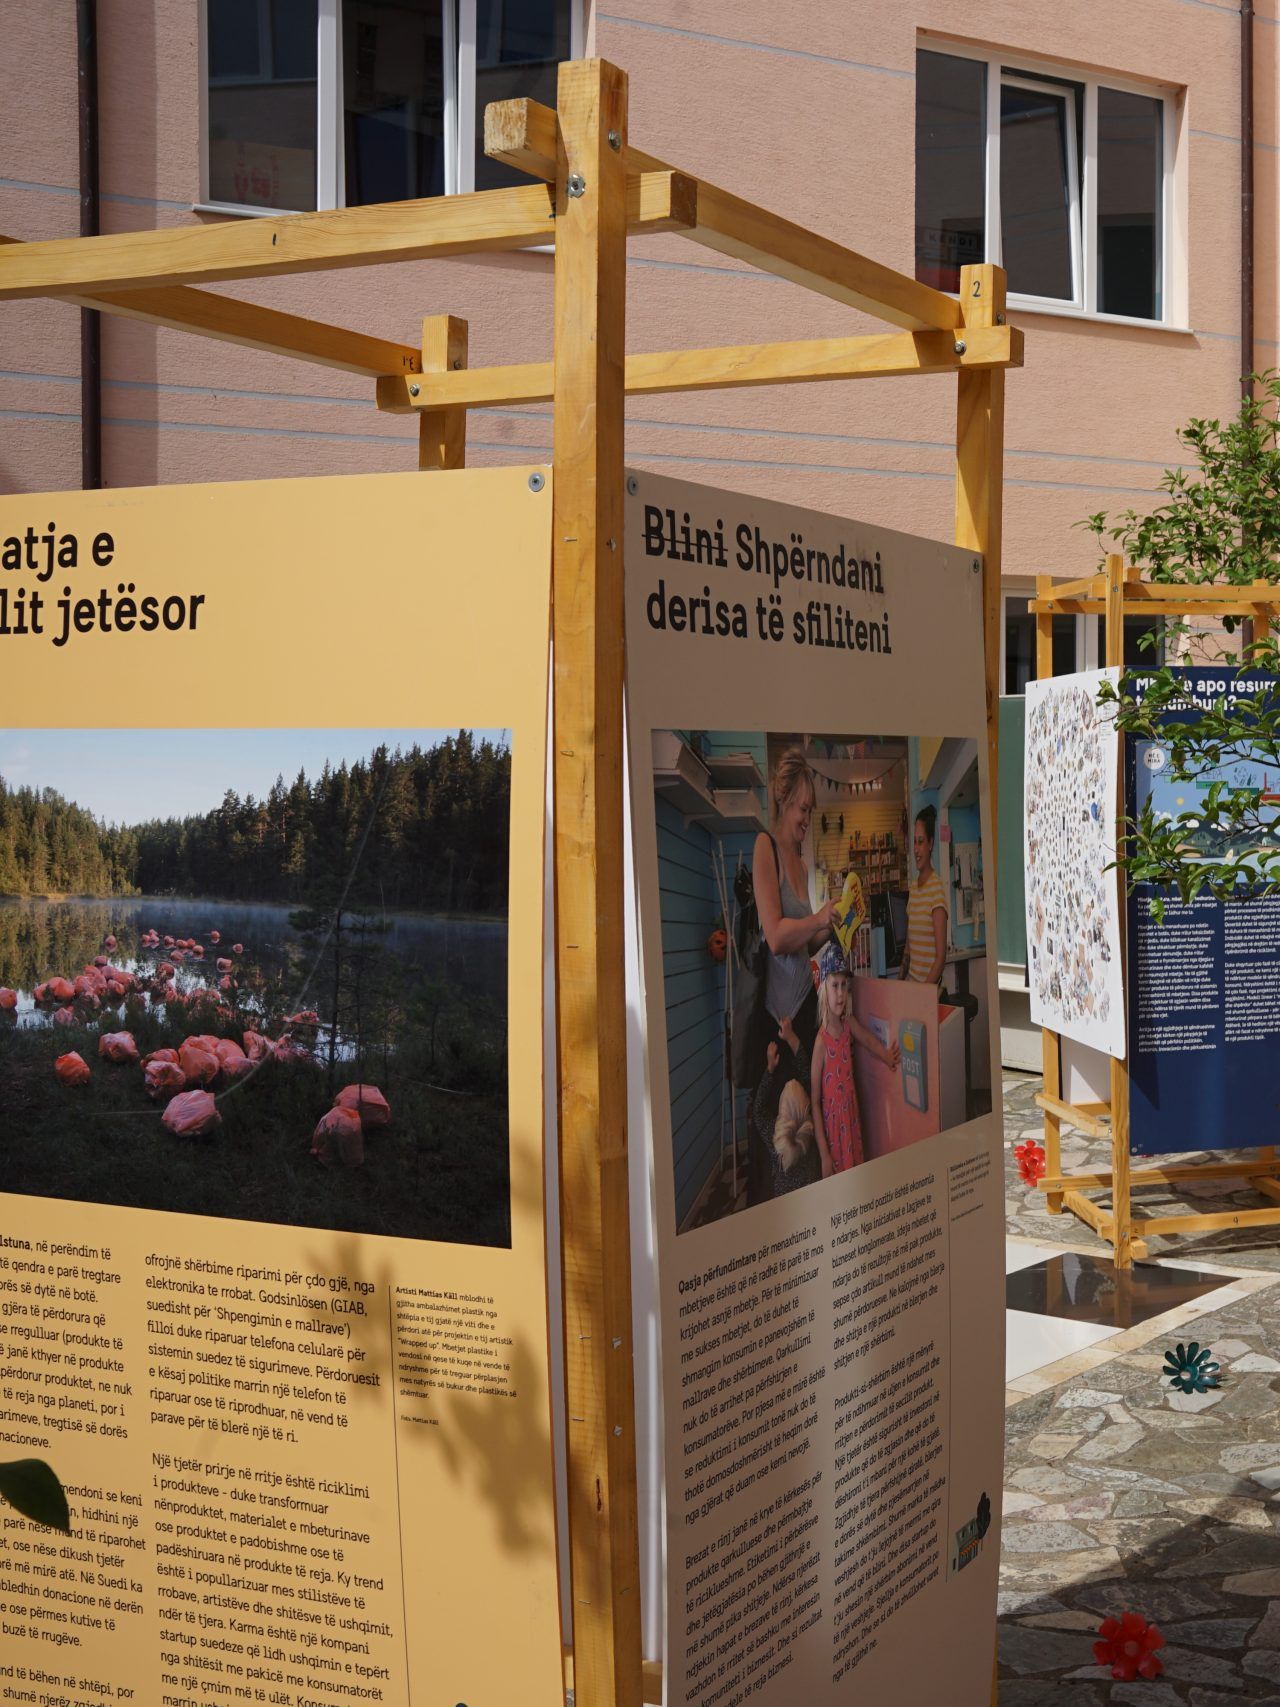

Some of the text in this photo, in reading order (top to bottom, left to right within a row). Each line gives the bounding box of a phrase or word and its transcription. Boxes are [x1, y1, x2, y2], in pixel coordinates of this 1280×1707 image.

[973, 280, 981, 297] 2
[1, 522, 115, 582] atja e
[643, 505, 885, 594] Blini Shpërndani
[52, 582, 206, 647] jetësor
[646, 580, 892, 654] derisa të sfiliteni
[1196, 680, 1226, 696] apo
[35, 1239, 48, 1252] në
[50, 1242, 98, 1258] perëndim
[100, 1247, 111, 1260] të
[11, 1260, 45, 1274] qendra
[47, 1265, 54, 1275] e
[56, 1265, 79, 1279] parë
[81, 1267, 121, 1284] tregtare
[144, 1253, 375, 1296] ofrojnë shërbime riparimi për çdo gjë, nga
[679, 1275, 700, 1294] Qasja
[704, 1253, 756, 1286] përfundimtare
[20, 1281, 32, 1294] së
[33, 1282, 56, 1299] dytë
[58, 1286, 71, 1299] në
[73, 1287, 98, 1303] botë.
[145, 1275, 368, 1317] elektronika te rrobat. Godsinlösen (GIAB,
[396, 1286, 416, 1295] Artisti
[419, 1289, 442, 1298] Mattias
[1, 1300, 106, 1328] gjëra të përdorura që
[146, 1300, 191, 1316] suedisht
[193, 1304, 211, 1319] për
[284, 1318, 292, 1329] e
[10, 1325, 60, 1341] rregulluar
[62, 1329, 110, 1349] (produkte
[112, 1337, 123, 1350] të
[146, 1319, 366, 1363] filloi duke riparuar telefona celularë për
[6, 1343, 29, 1359] janë
[30, 1347, 62, 1365] kthyer
[64, 1353, 76, 1366] në
[78, 1356, 124, 1372] produkte
[148, 1342, 381, 1387] sistemin suedez të sigurimeve. Përdoruesit
[0, 1365, 132, 1396] përdorur produktet, ne nuk
[148, 1365, 346, 1405] e kësaj politike marrin një telefon të
[2, 1386, 125, 1416] të reja nga planeti, por i
[149, 1386, 348, 1428] riparuar ose të riprodhuar, në vend të
[43, 1414, 83, 1432] tregtisë
[85, 1421, 97, 1434] së
[99, 1422, 128, 1439] dorës
[150, 1411, 298, 1443] parave për të blerë një të ri.
